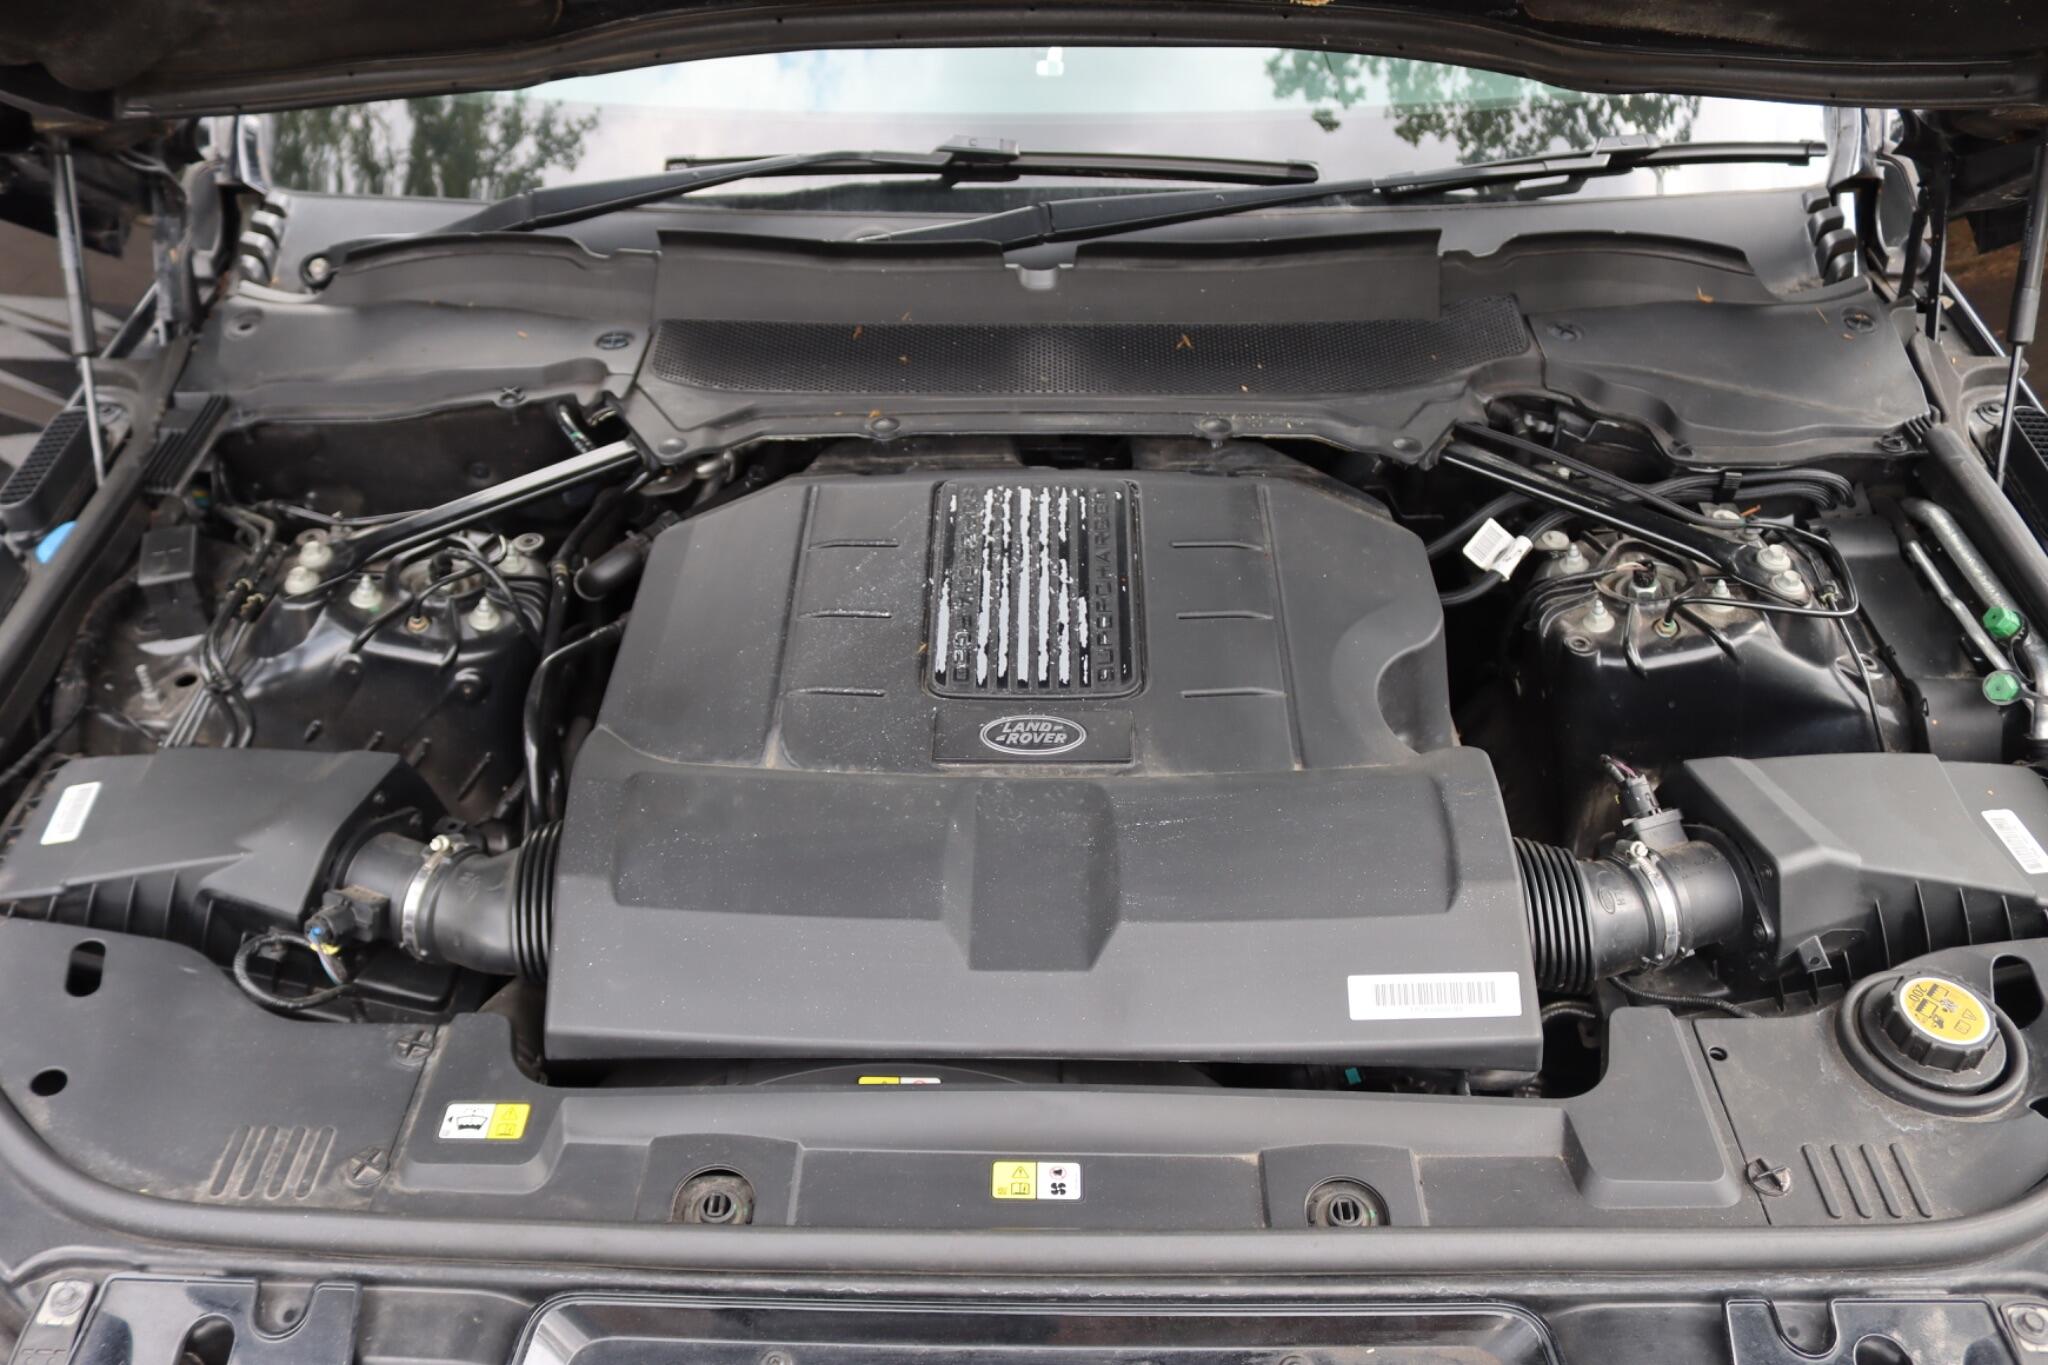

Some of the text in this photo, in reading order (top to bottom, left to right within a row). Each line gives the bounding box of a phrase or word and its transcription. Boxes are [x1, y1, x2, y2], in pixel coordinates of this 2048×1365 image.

[1094, 491, 1115, 682] SUPERCHARGED
[1002, 722, 1053, 733] LAND
[1006, 732, 1067, 744] ROVER
